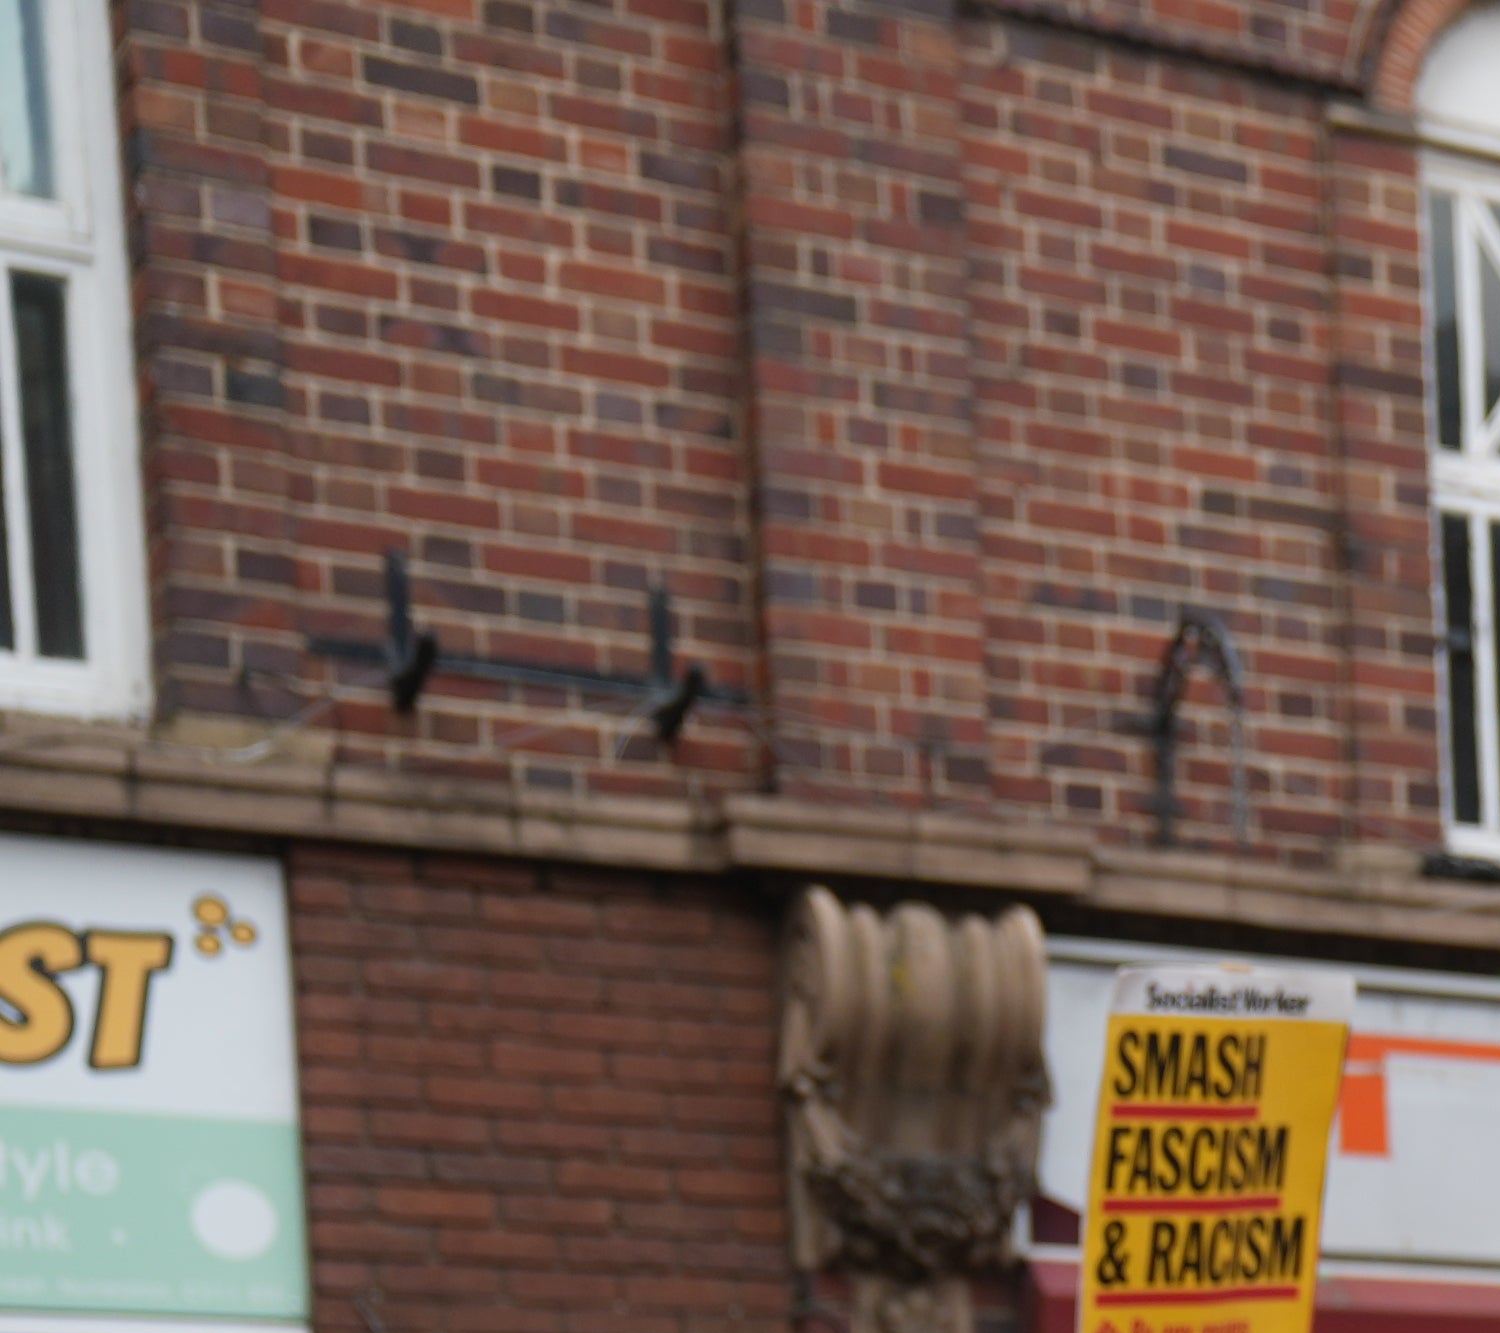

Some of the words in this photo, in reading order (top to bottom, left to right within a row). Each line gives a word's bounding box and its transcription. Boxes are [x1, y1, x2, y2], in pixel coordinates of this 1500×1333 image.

[1114, 1030, 1267, 1100] SMASH
[1106, 1124, 1290, 1195] FASCISM
[1096, 1219, 1129, 1287] &
[1147, 1216, 1307, 1286] RACISM
